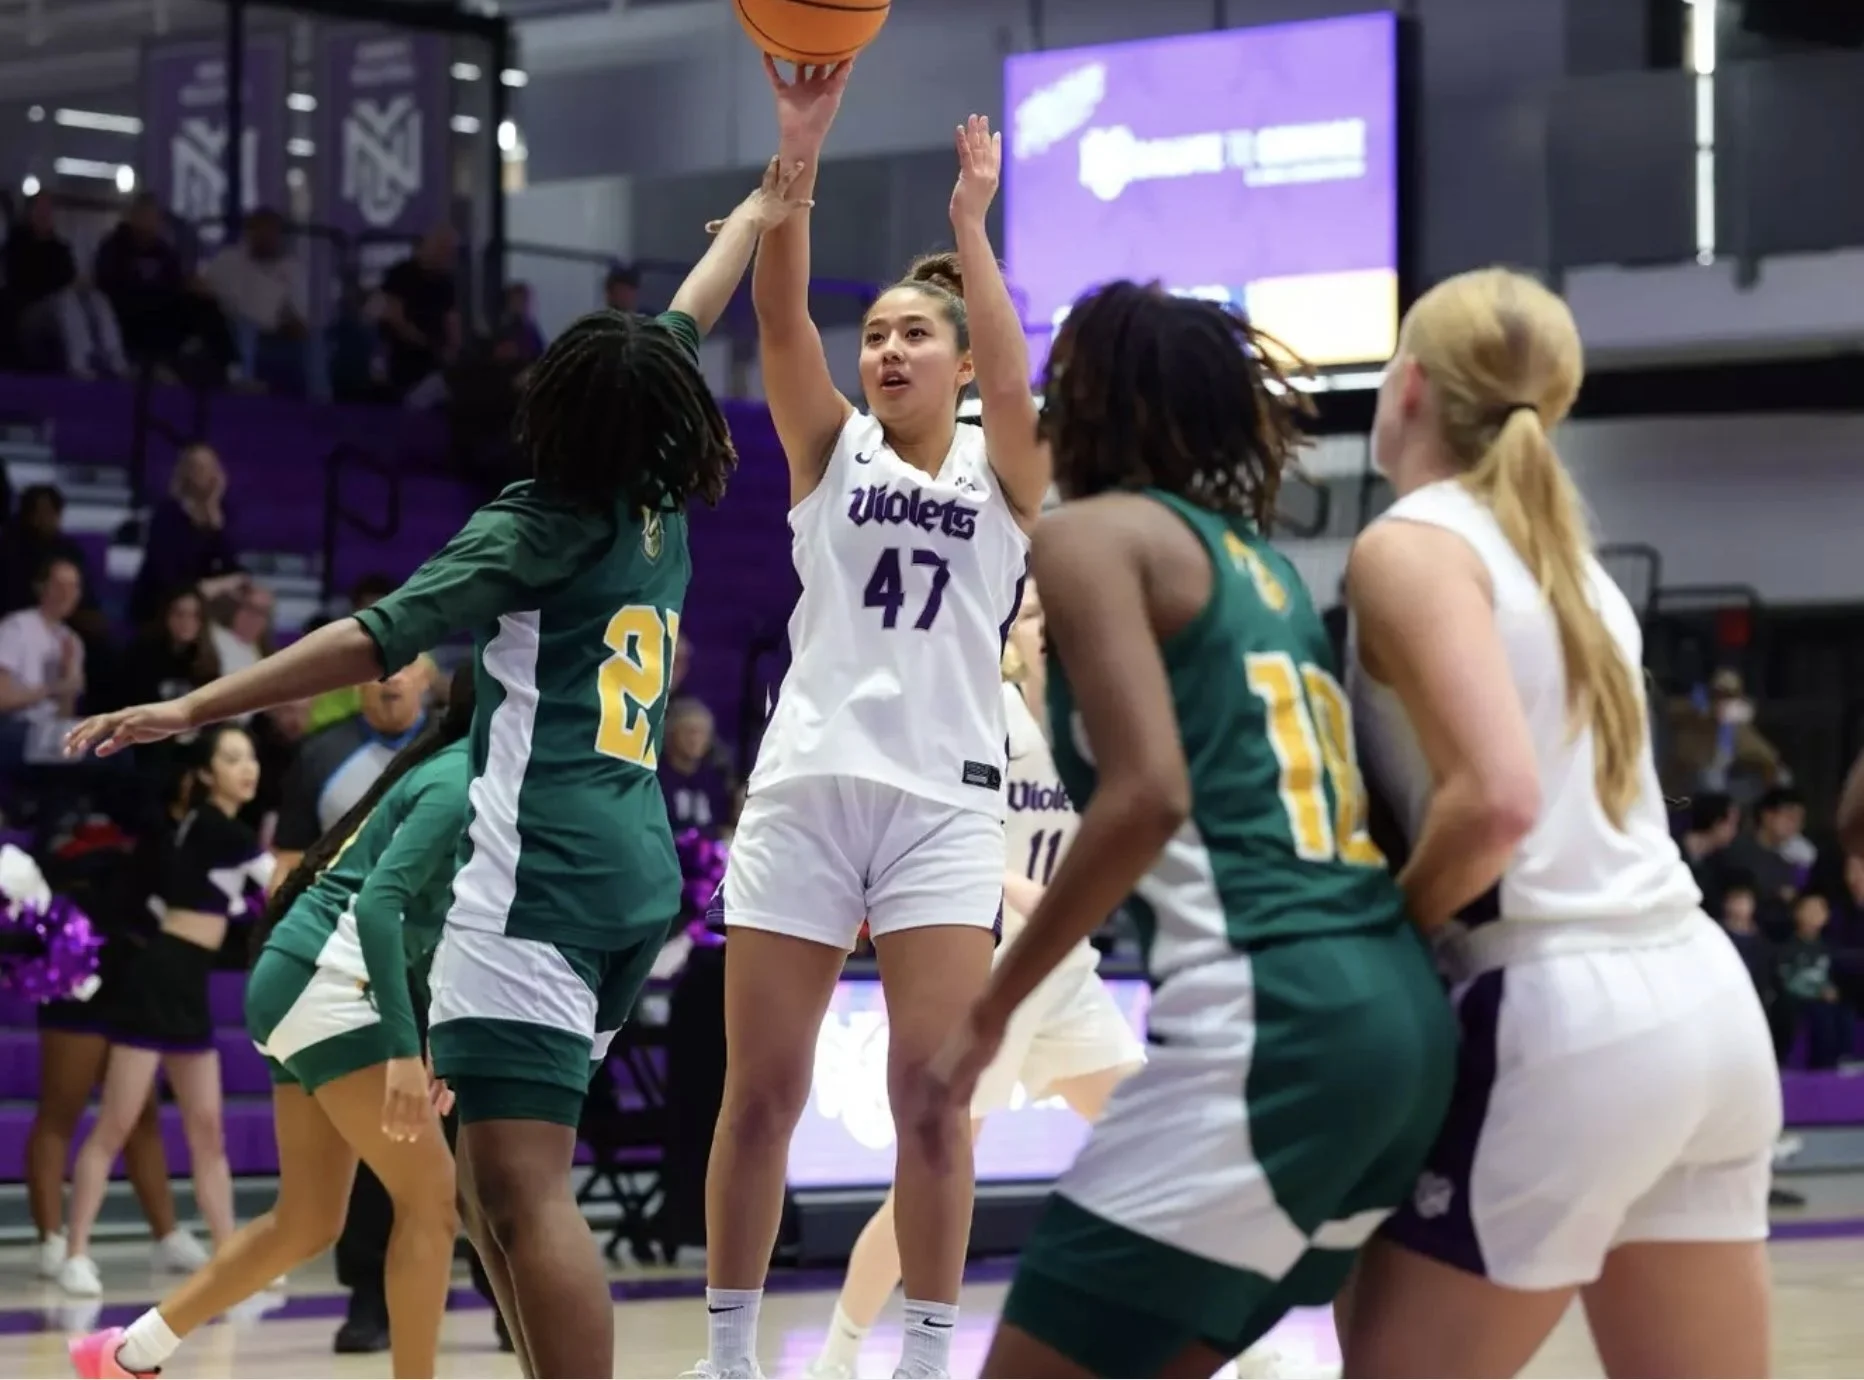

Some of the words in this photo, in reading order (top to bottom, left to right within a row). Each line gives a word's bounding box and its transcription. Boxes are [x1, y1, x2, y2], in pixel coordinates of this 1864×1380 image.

[848, 484, 979, 540] Violets
[863, 547, 950, 630] 47
[1027, 829, 1062, 886] 11
